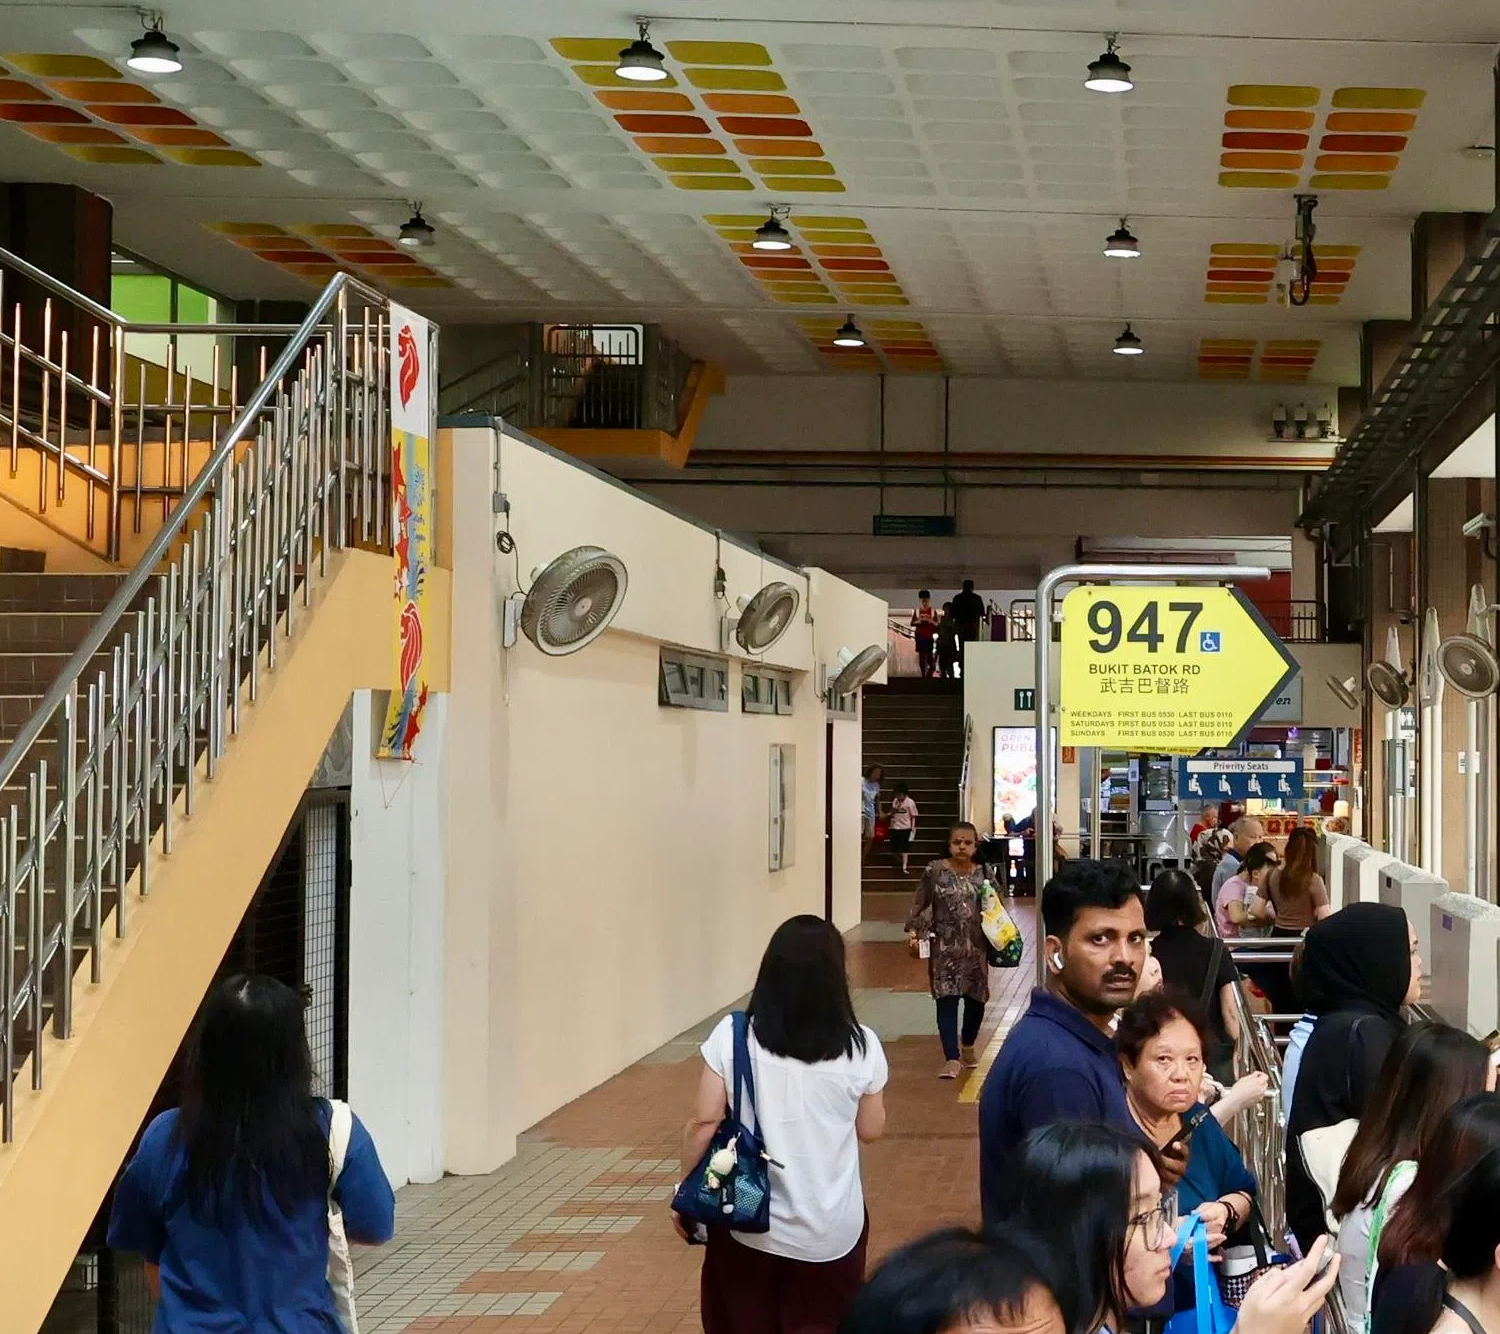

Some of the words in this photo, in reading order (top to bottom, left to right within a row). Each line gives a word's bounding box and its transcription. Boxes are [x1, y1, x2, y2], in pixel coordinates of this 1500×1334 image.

[1087, 600, 1203, 653] 947
[1089, 664, 1129, 675] BUKIT
[1133, 664, 1178, 675] BATOK
[1182, 664, 1201, 675] RD
[1100, 677, 1190, 694] 武吉巴督路
[1070, 720, 1115, 728] SATURDAYS
[1118, 720, 1139, 728] FIRST
[1141, 720, 1157, 728] BUS
[1158, 720, 1175, 728] 0530
[1179, 720, 1197, 728] LAST
[1199, 720, 1215, 728] BUS
[1216, 720, 1233, 728] 0110
[1214, 761, 1245, 772] Priority
[1247, 761, 1269, 770] Seats
